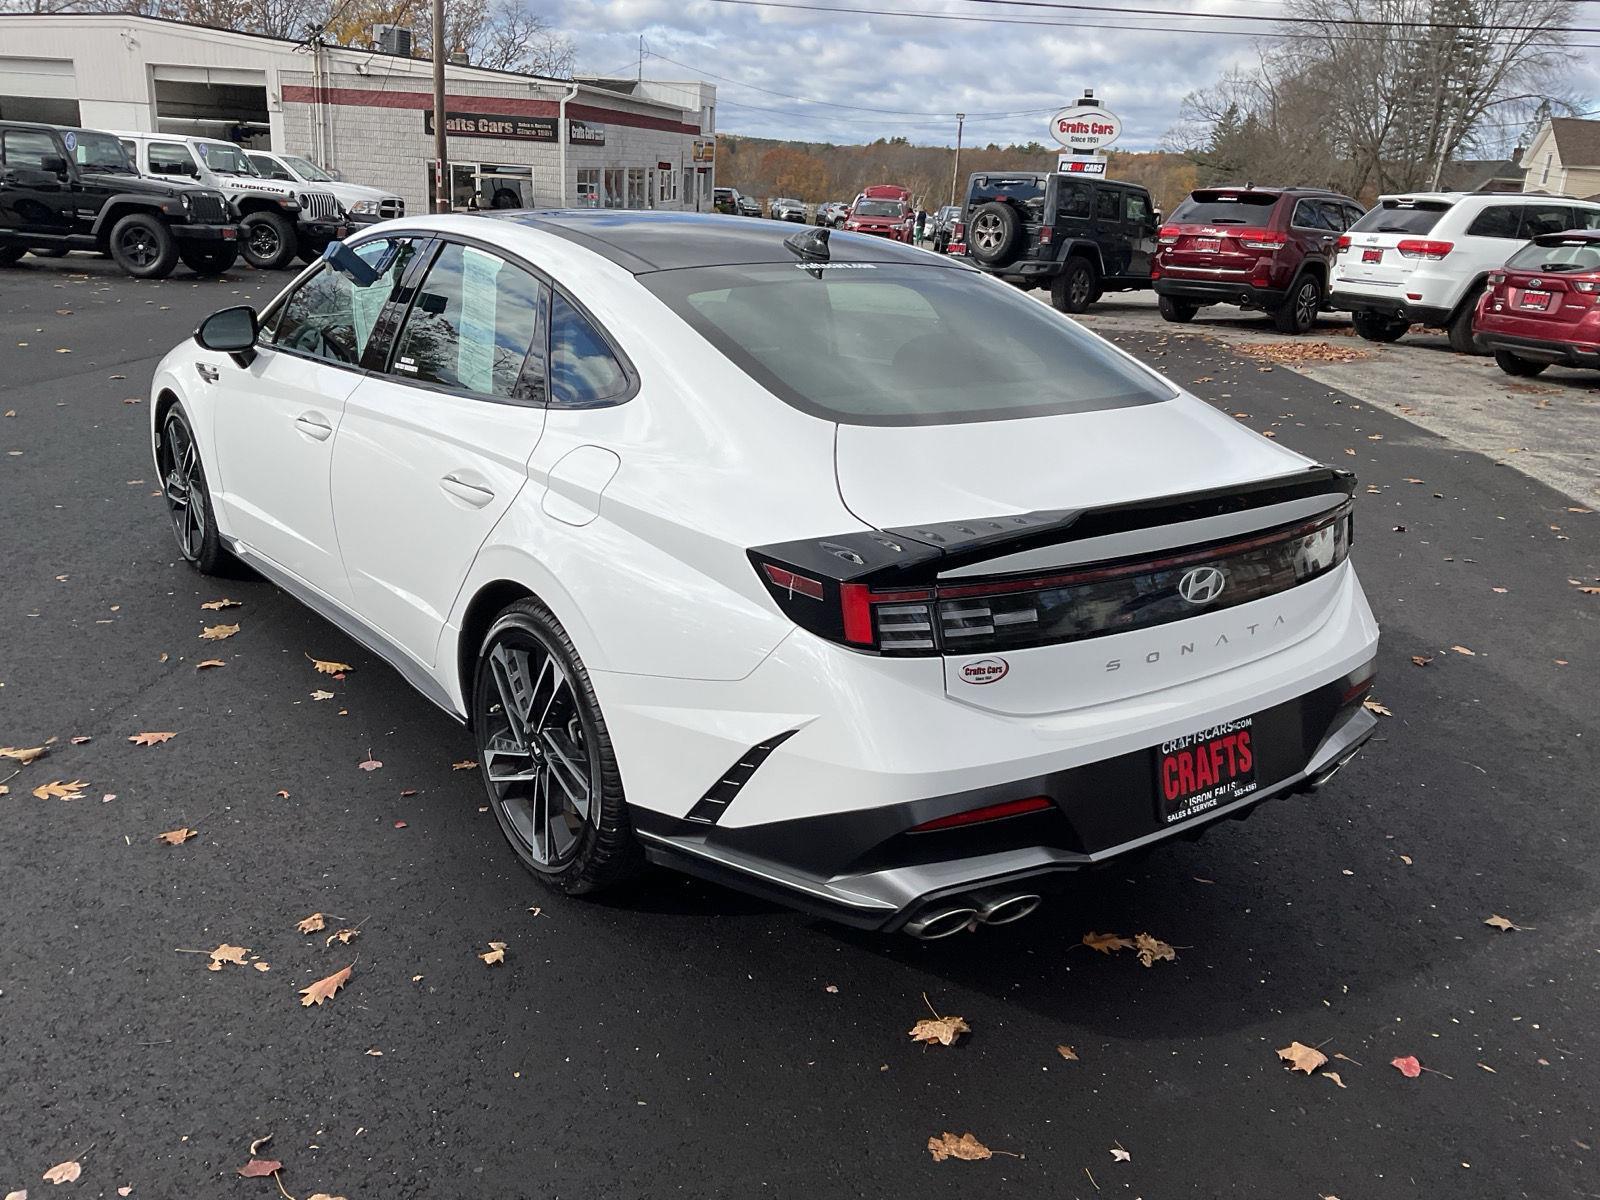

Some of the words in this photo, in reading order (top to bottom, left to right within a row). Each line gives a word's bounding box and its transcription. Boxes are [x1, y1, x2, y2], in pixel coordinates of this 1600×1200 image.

[430, 116, 474, 131] afts
[478, 118, 514, 133] Cars
[1060, 121, 1090, 134] Crafts
[1091, 122, 1114, 135] Cars
[1070, 135, 1086, 143] Since
[1087, 136, 1099, 144] 1951
[1084, 163, 1103, 173] CARS
[231, 182, 285, 194] RUBICON
[1105, 615, 1285, 672] SONATA
[964, 667, 986, 676] Crafts
[987, 666, 1003, 675] Cars
[1162, 717, 1252, 754] CRAFTSCARSCOM
[1163, 730, 1253, 800] CRAFTS
[1184, 790, 1213, 806] ISBON
[1167, 810, 1187, 823] SALES
[1192, 798, 1218, 813] SERVICE
